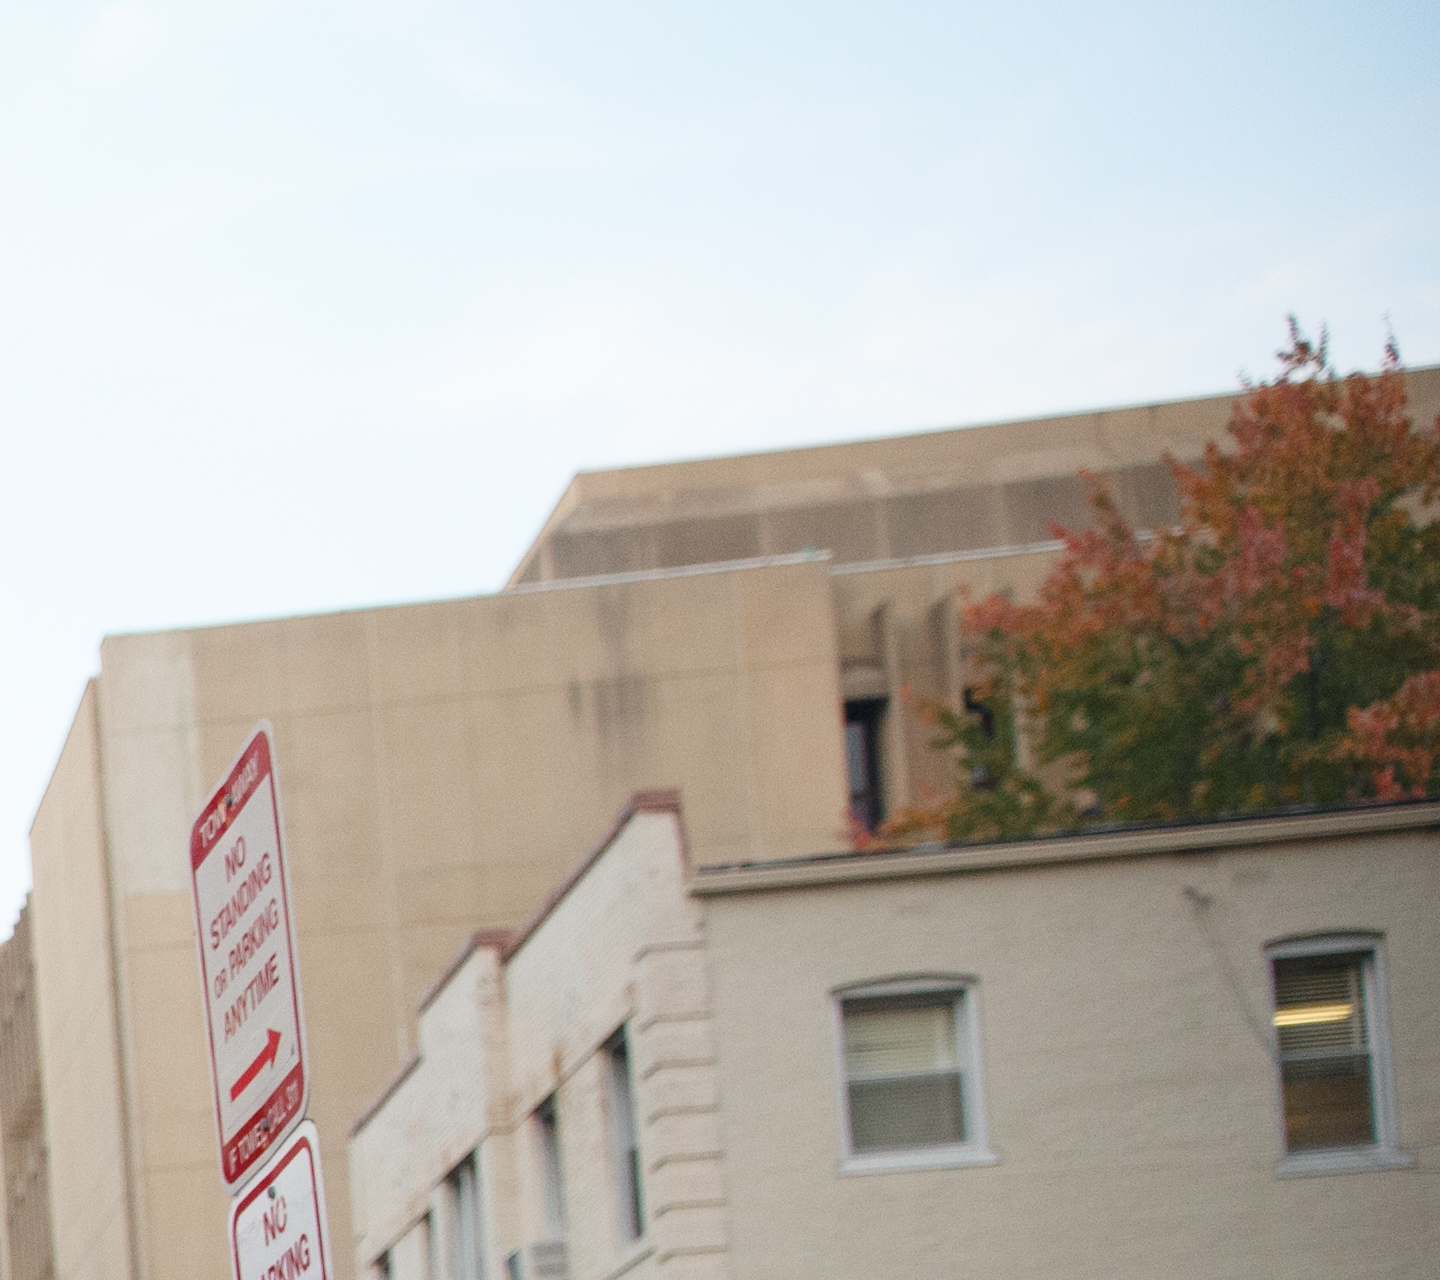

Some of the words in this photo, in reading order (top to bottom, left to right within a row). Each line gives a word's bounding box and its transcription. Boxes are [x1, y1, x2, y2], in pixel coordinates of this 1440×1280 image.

[210, 852, 271, 950] STANDING
[225, 836, 246, 884] NO
[214, 968, 227, 999] OR
[228, 897, 278, 980] PARKING
[224, 952, 279, 1044] ANYTIME
